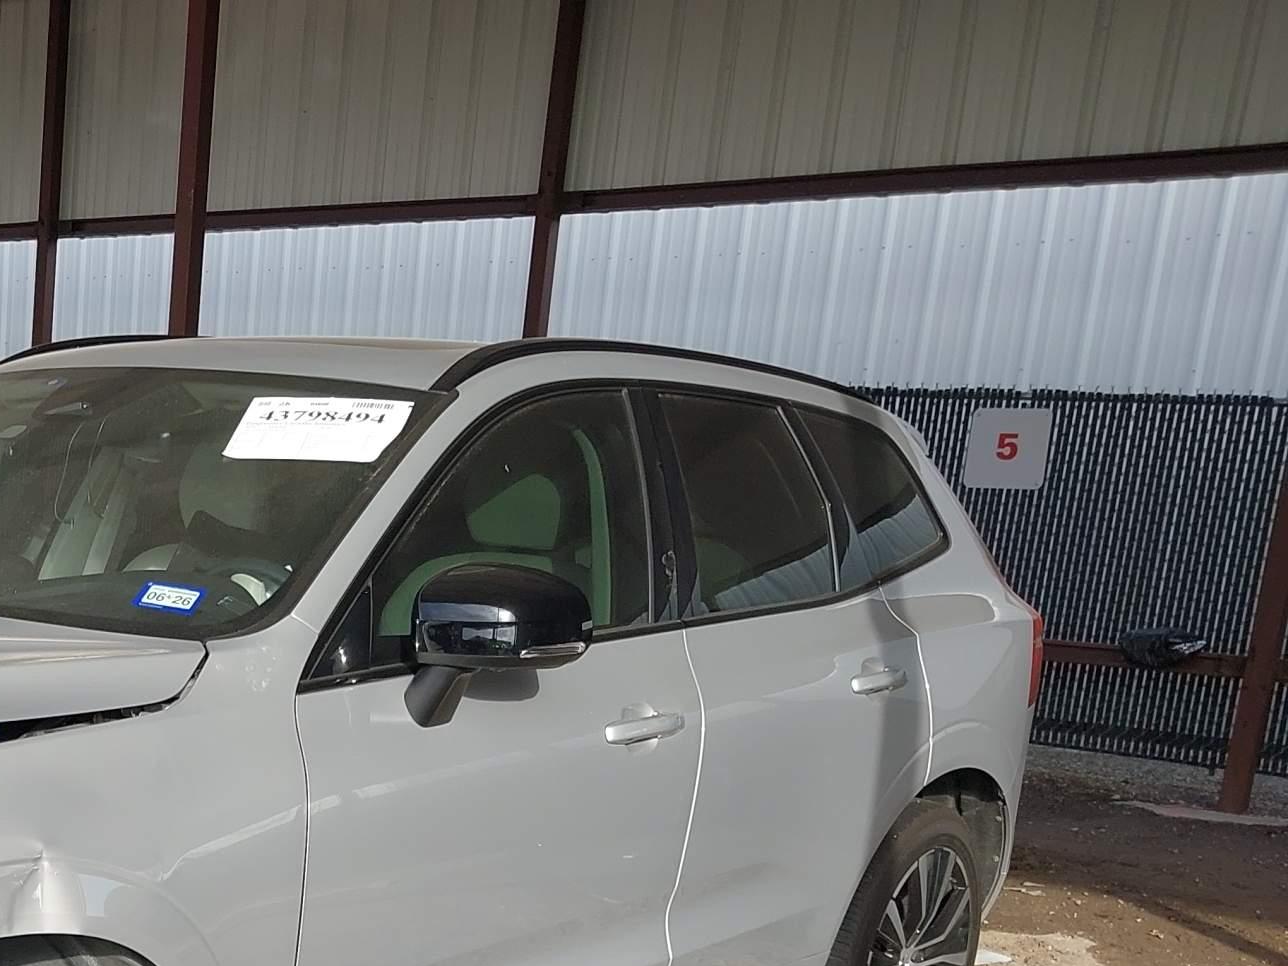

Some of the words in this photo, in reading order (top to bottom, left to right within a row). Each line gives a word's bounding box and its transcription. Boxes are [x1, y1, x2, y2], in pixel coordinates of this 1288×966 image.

[259, 410, 386, 424] 43798494
[995, 432, 1019, 461] 5
[146, 591, 167, 602] 06
[171, 595, 193, 606] 26
